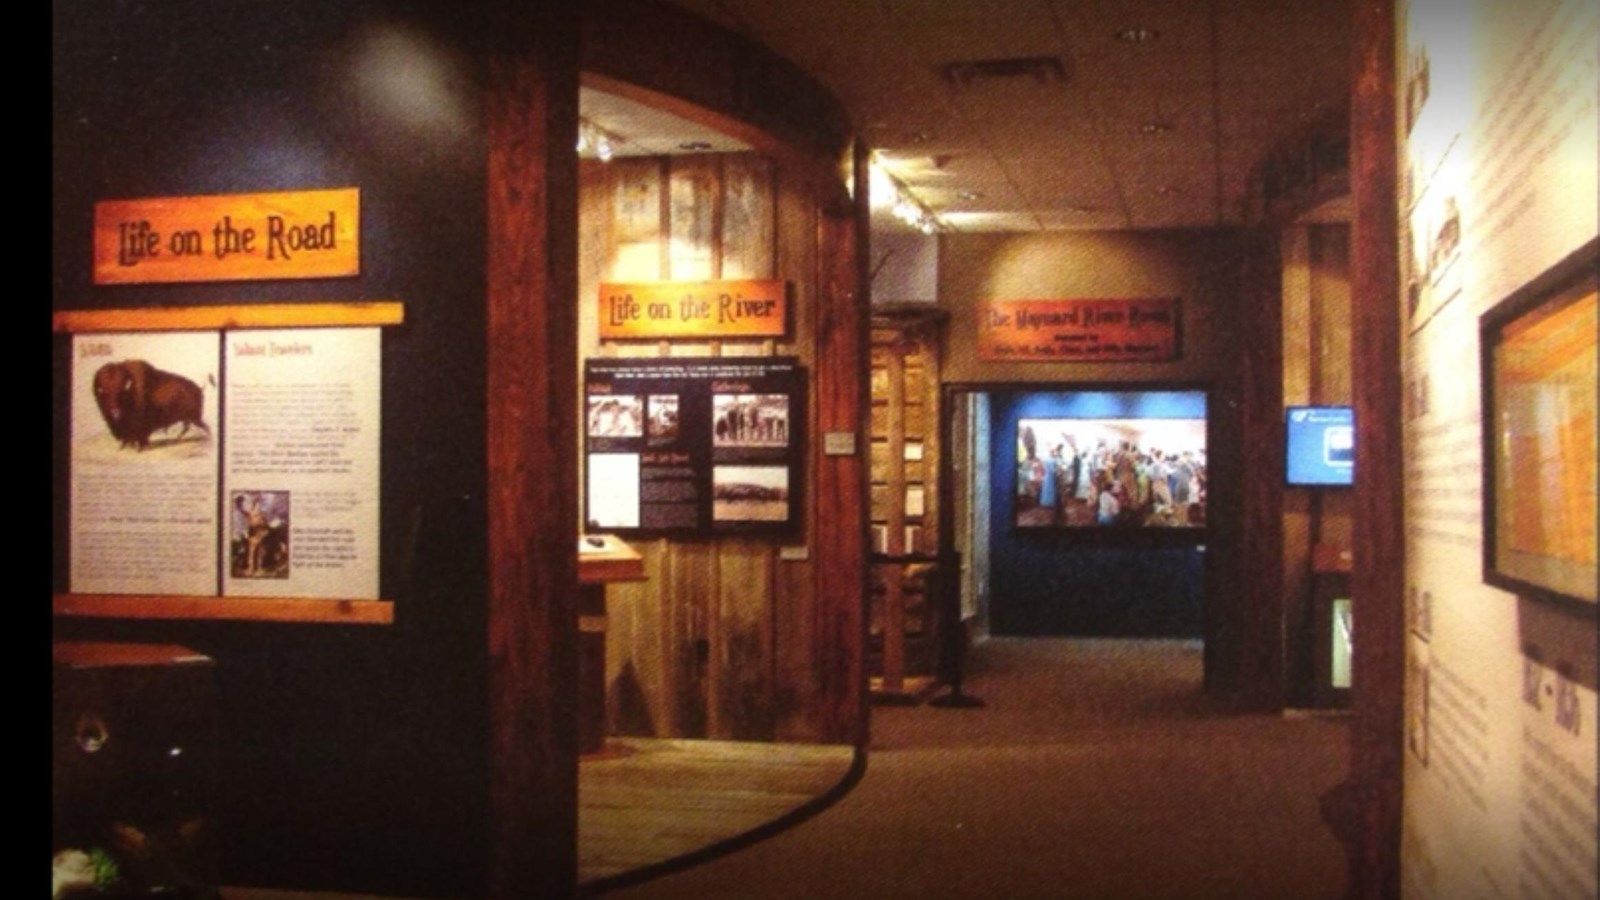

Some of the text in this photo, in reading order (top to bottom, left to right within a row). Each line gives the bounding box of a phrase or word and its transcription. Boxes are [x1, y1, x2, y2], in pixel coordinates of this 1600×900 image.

[117, 210, 337, 267] Life on the Road
[608, 293, 776, 327] Life on the River
